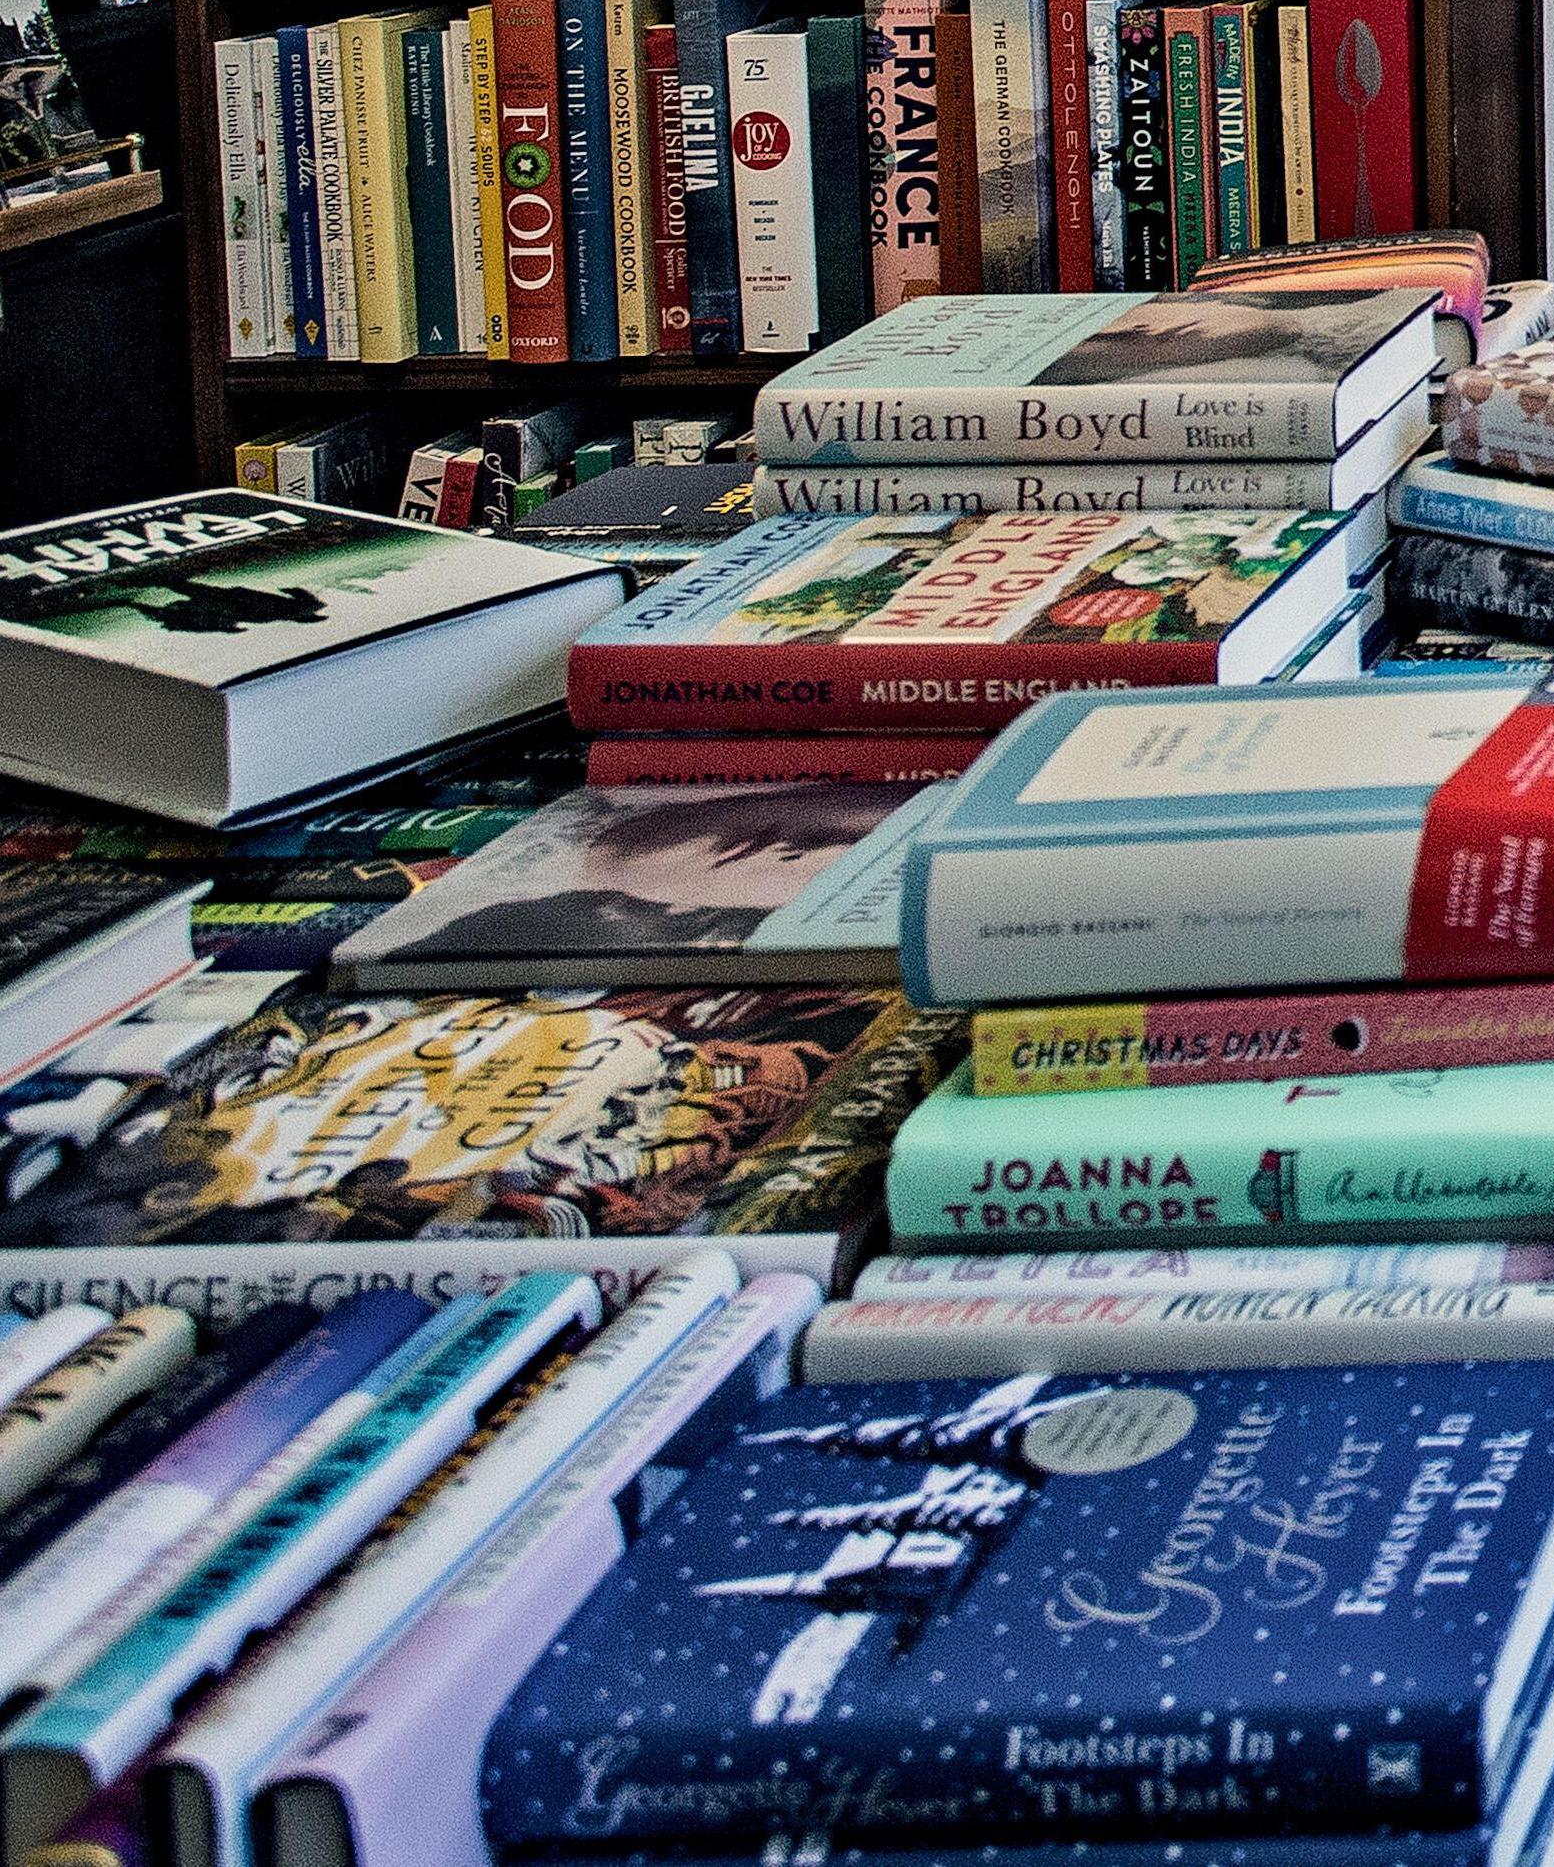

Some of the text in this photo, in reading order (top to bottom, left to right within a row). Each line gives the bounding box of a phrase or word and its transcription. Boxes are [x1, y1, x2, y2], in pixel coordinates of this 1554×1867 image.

[680, 84, 719, 192] GJELINA
[893, 25, 938, 250] FRANCE
[1061, 11, 1080, 231] OTTOLENGHI
[1129, 59, 1154, 193] ZAITOUN
[1178, 44, 1195, 184] FRESH INDIA
[613, 69, 637, 293] MOOSEWOOD COOKBOOK
[511, 336, 559, 348] OXFORD
[778, 399, 1150, 450] William Boyd
[1175, 393, 1264, 419] Love is
[1185, 425, 1255, 449] Blind
[882, 515, 1052, 629] MIDDLE
[944, 514, 1122, 632] ENGLAND
[602, 679, 834, 706] JONATHAN COE
[269, 1016, 510, 1189] SILENCE
[459, 1034, 624, 1156] GIRLS
[1011, 1026, 1303, 1071] CHRISTMAS DAYS
[970, 1157, 1197, 1191] JOANNA
[1333, 1413, 1475, 1617] Footsteps In
[1413, 1428, 1534, 1595] The Dark
